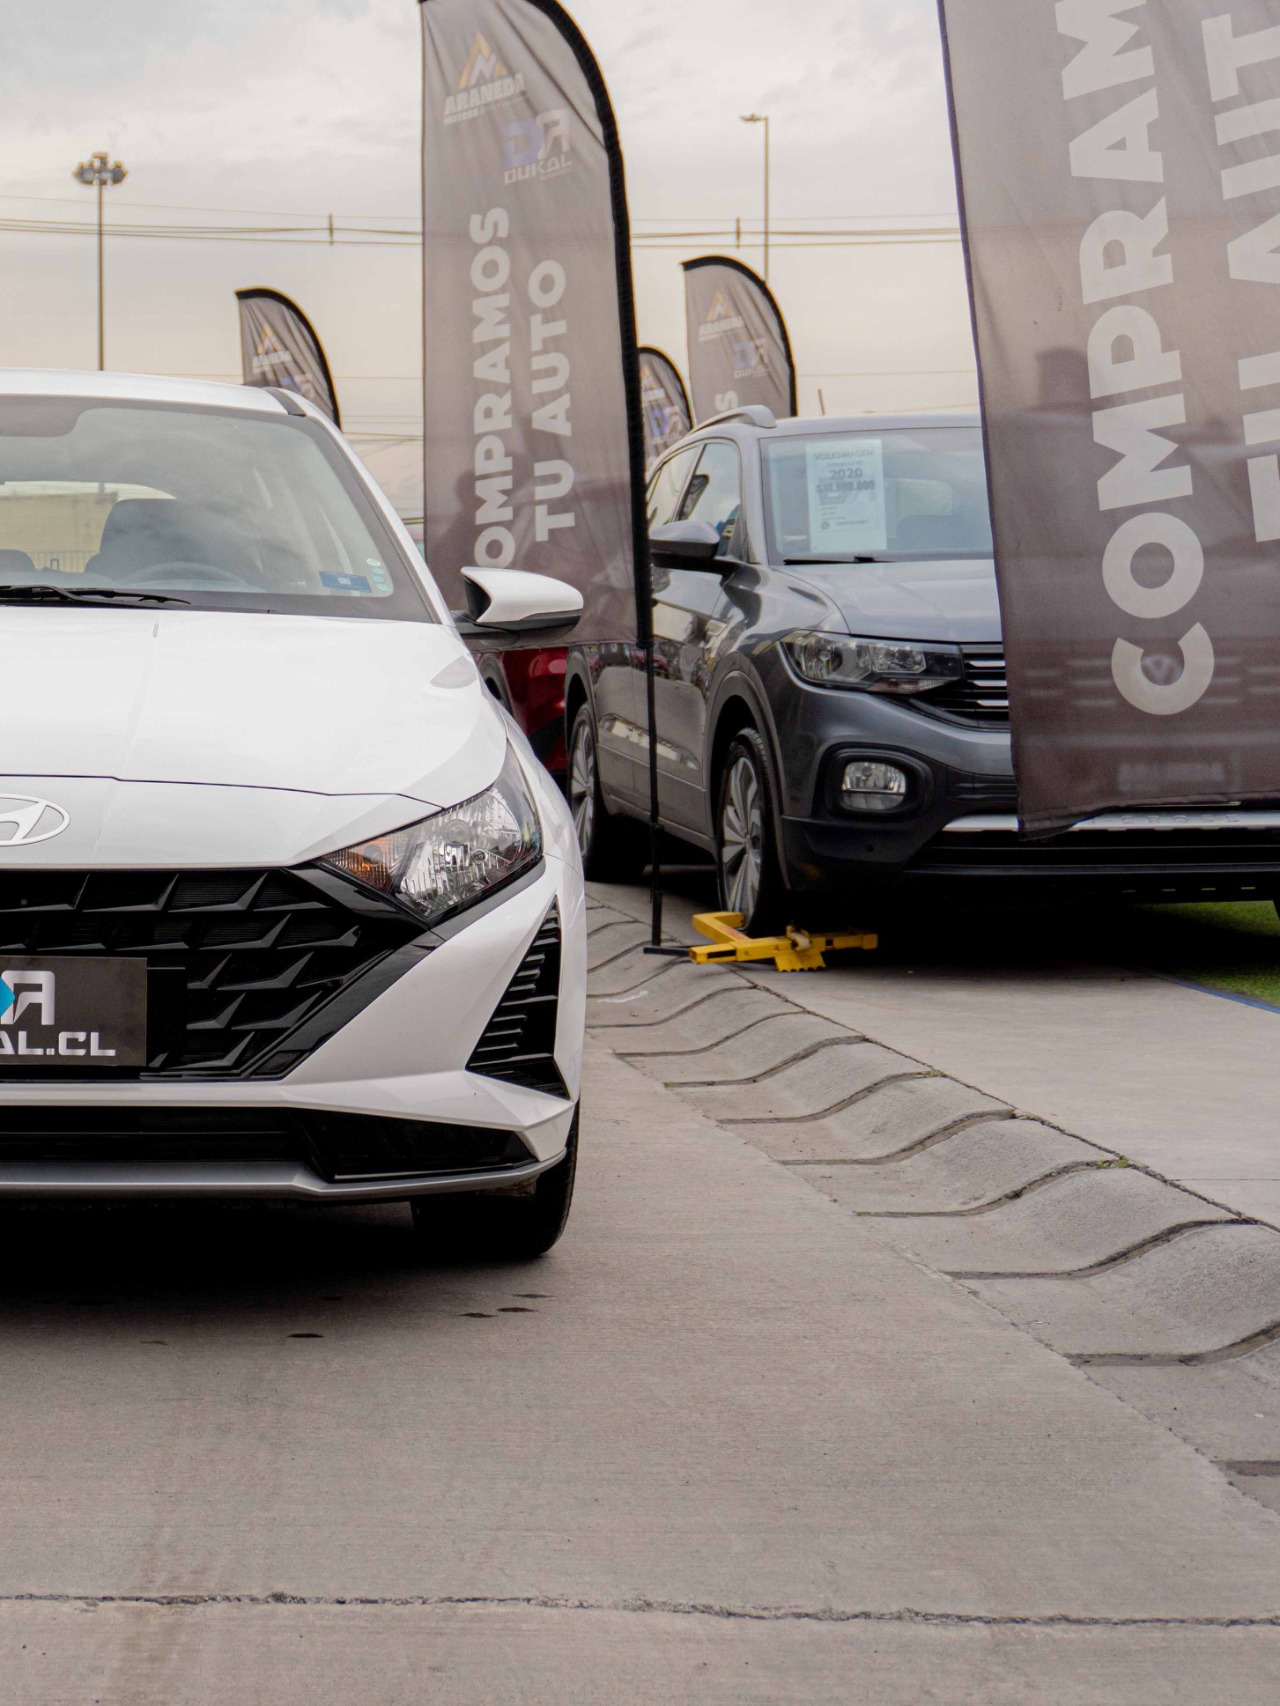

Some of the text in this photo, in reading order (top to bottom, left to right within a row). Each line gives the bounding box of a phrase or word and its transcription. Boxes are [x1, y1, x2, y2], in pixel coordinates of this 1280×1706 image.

[444, 72, 525, 116] ARANEDA
[504, 154, 573, 185] DUKAL
[469, 206, 517, 569] OMPRAMOS
[527, 259, 576, 542] TU AUTO
[814, 449, 874, 460] VOLKSWAGEN
[829, 467, 863, 480] 2020
